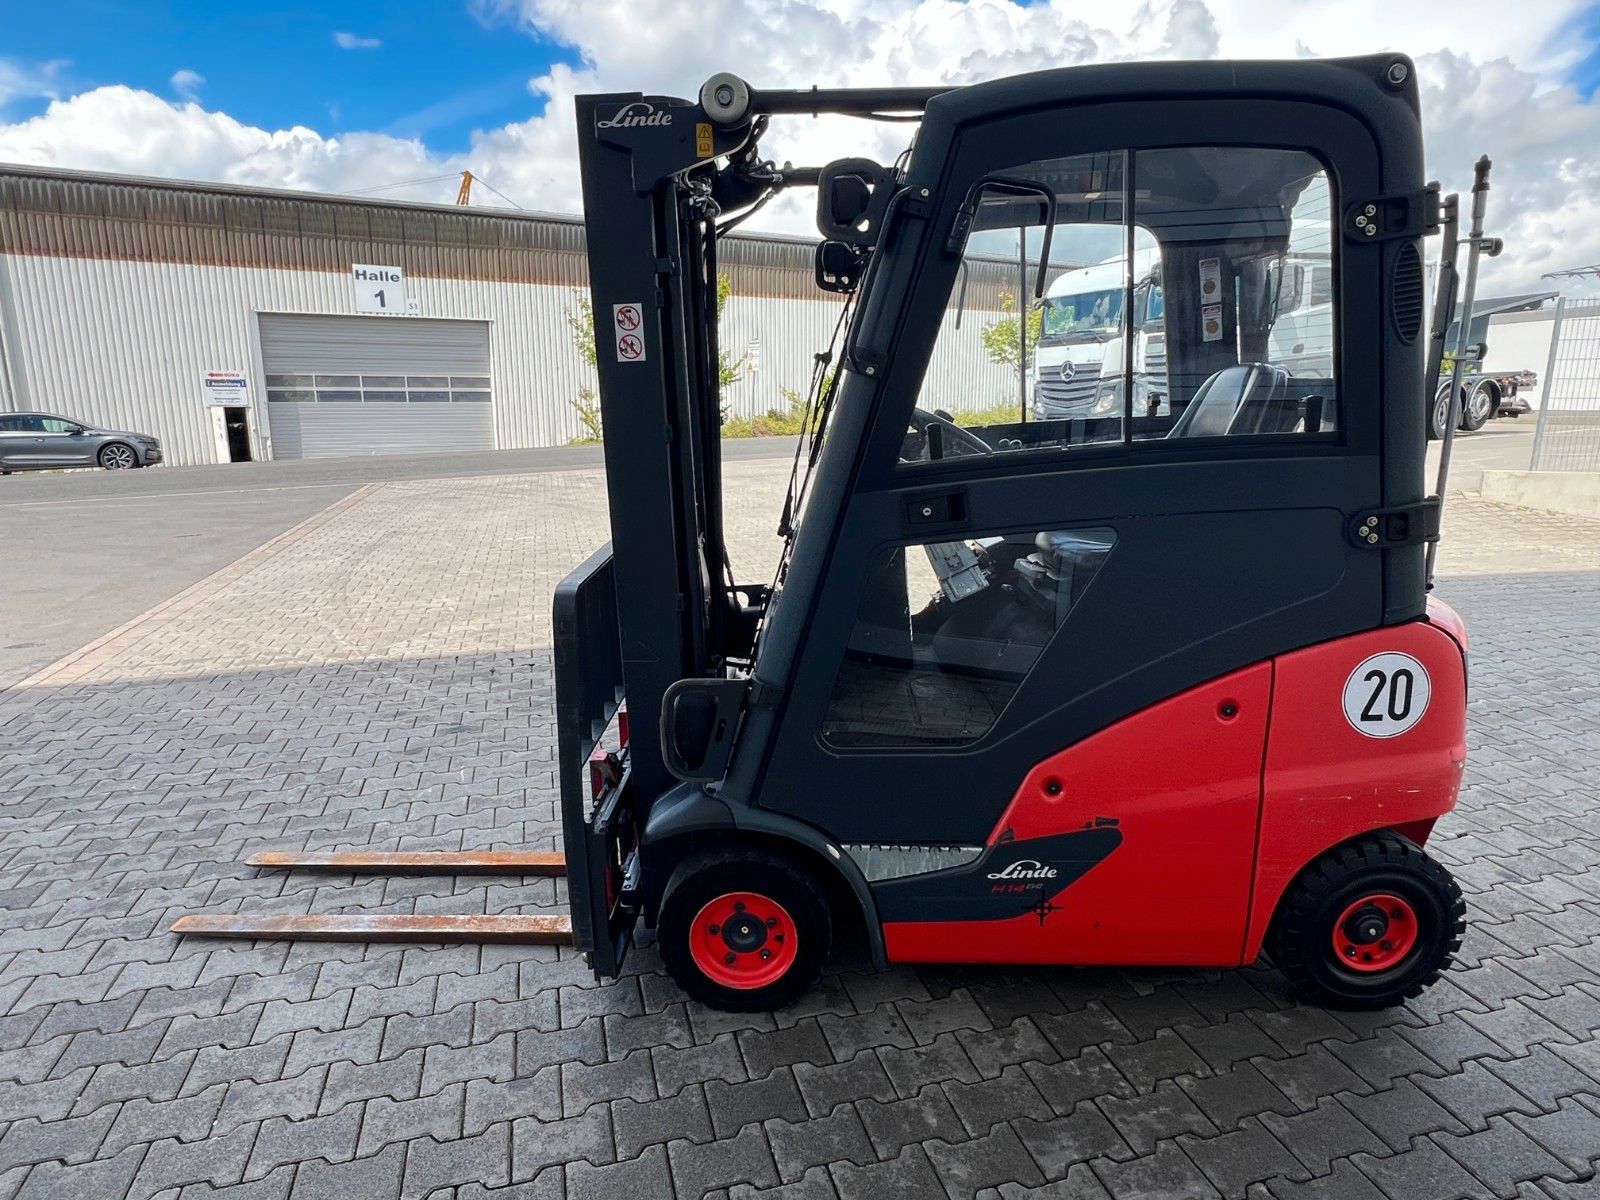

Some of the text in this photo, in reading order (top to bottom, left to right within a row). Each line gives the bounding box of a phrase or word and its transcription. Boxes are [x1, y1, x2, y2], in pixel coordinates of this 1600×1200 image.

[597, 102, 672, 128] Linde
[354, 269, 401, 282] Halle
[374, 289, 386, 308] 1
[1360, 668, 1414, 721] 20
[987, 859, 1058, 879] Linde
